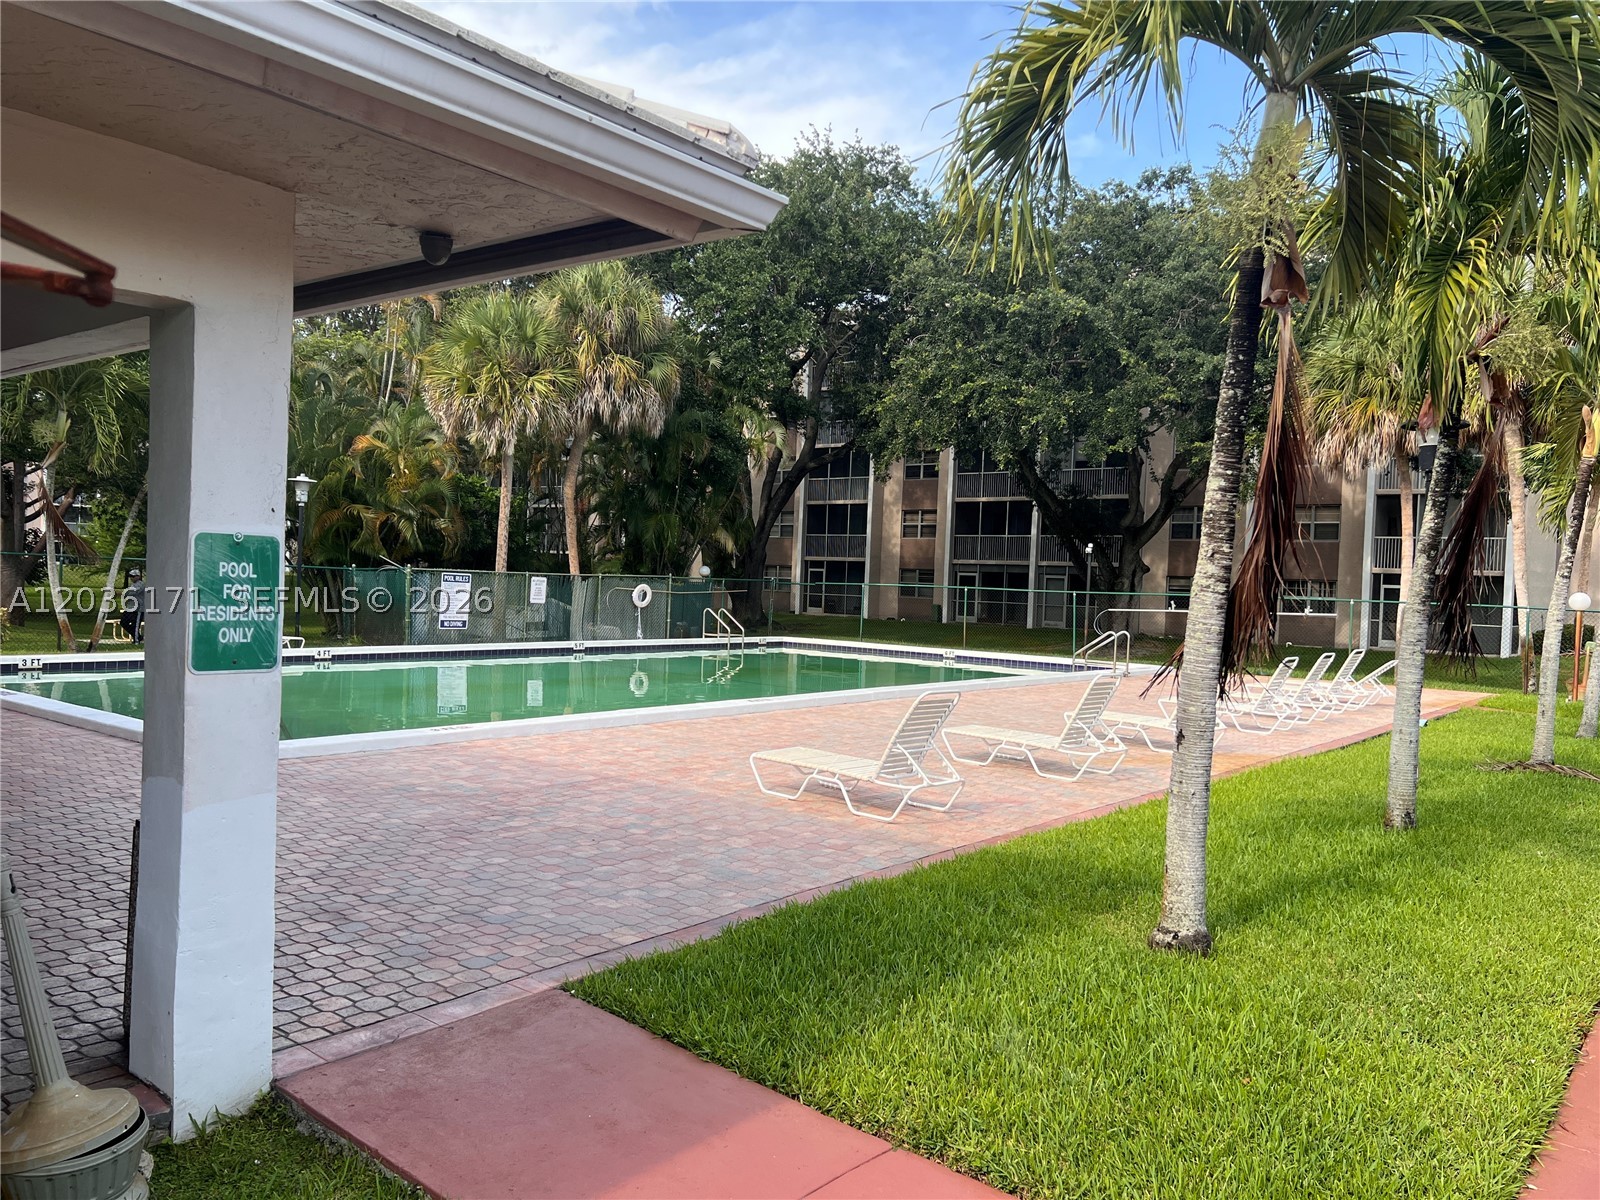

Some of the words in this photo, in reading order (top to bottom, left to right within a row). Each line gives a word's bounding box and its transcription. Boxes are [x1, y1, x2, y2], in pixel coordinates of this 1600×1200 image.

[219, 561, 257, 578] POOL
[223, 583, 252, 600] FOR
[196, 605, 275, 621] RESIDENTS
[218, 627, 254, 643] ONLY
[21, 658, 27, 667] 3
[30, 658, 41, 667] FT
